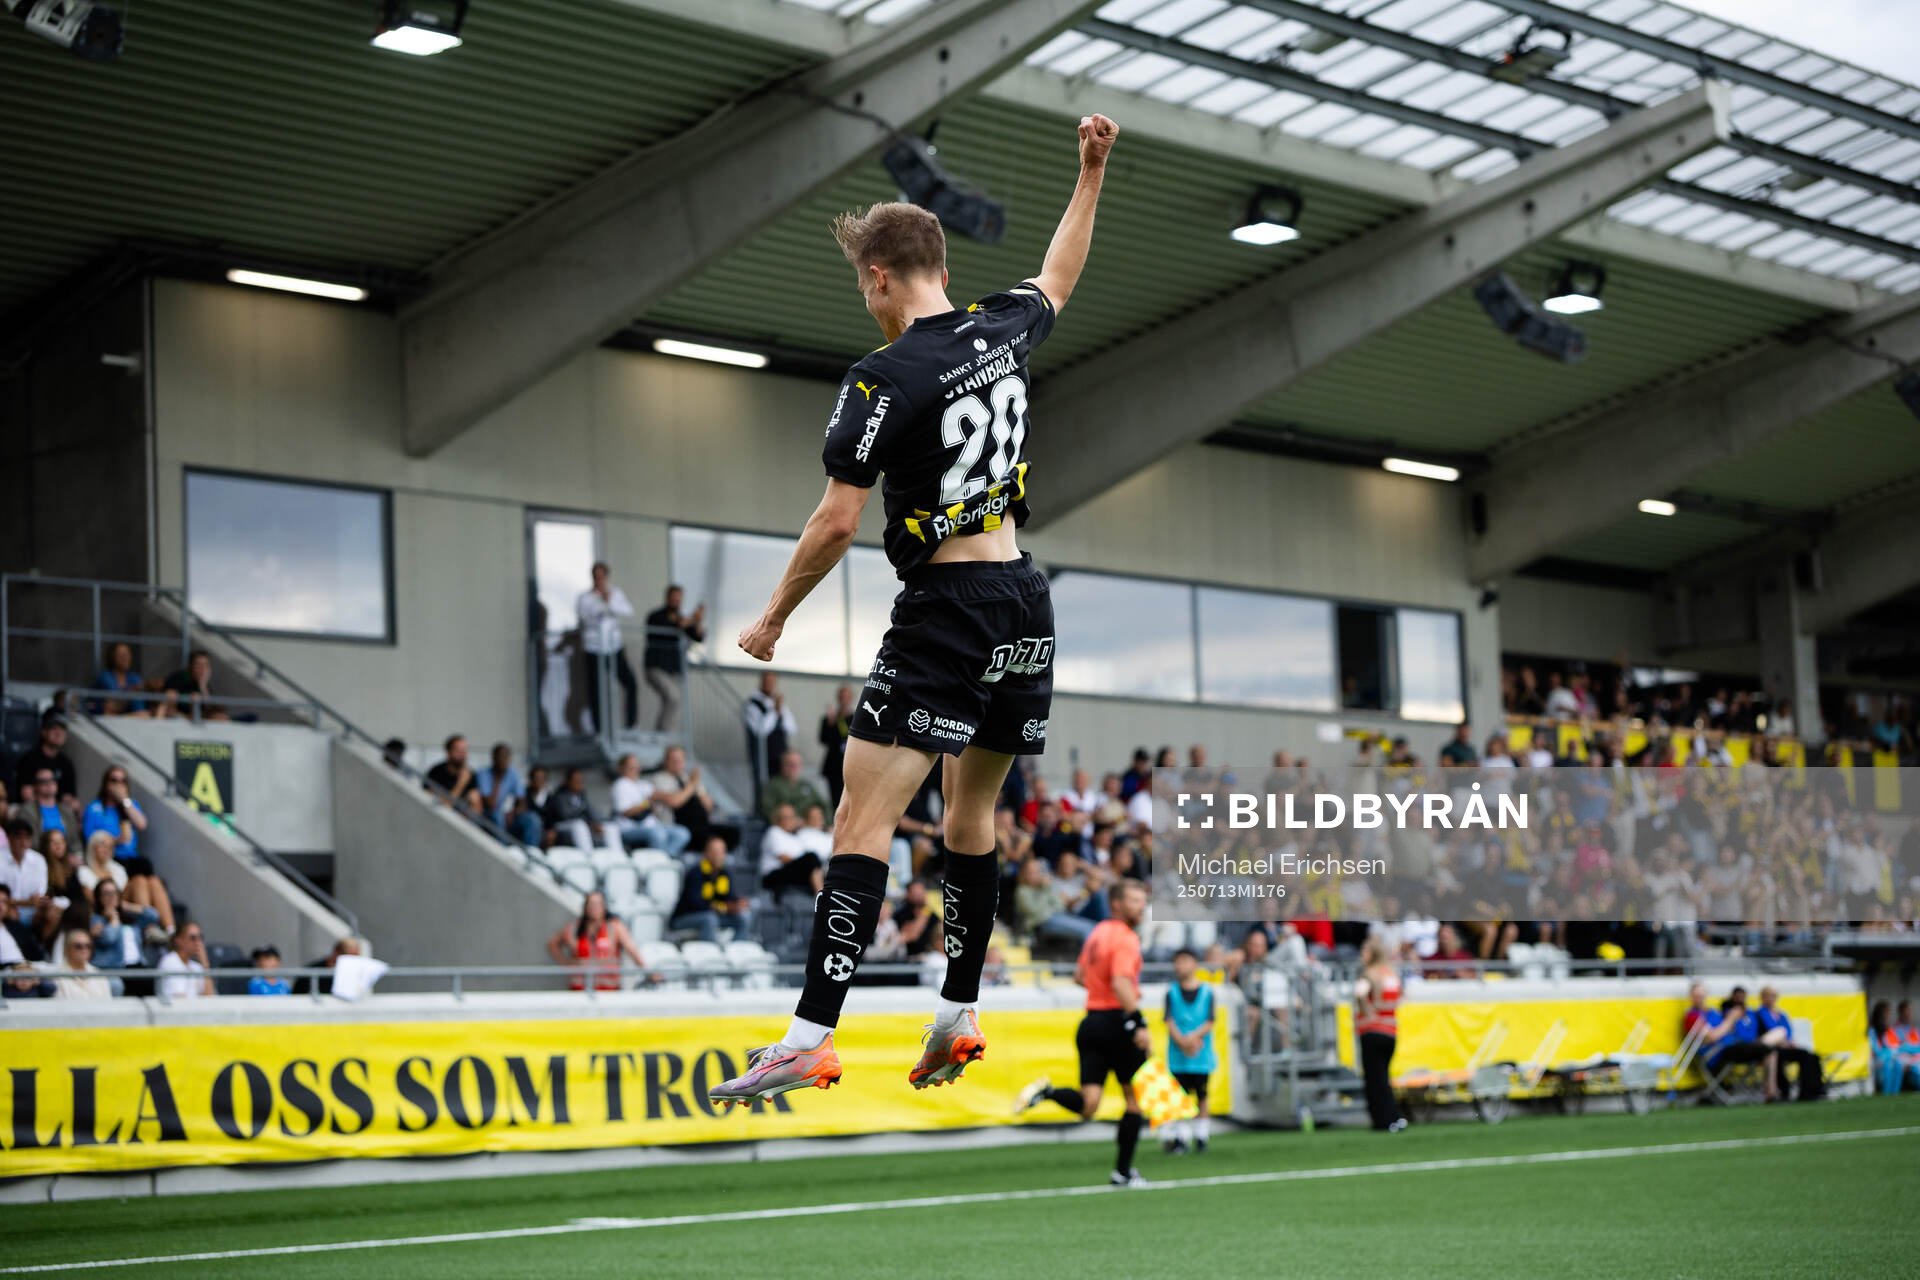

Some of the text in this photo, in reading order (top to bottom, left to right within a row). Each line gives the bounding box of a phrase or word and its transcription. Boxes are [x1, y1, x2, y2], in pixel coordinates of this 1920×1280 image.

[939, 330, 1028, 383] SANKT JÖRGEN PARK
[825, 384, 849, 437] stadiu
[855, 395, 891, 463] stadium
[940, 374, 1028, 506] 20
[932, 491, 1010, 540] Hybridge
[186, 761, 224, 814] A
[828, 890, 862, 954] JOVI
[944, 883, 968, 935] JOVI
[0, 1062, 188, 1150] LLA
[211, 1058, 374, 1140] OSS
[395, 1055, 571, 1131] SOM
